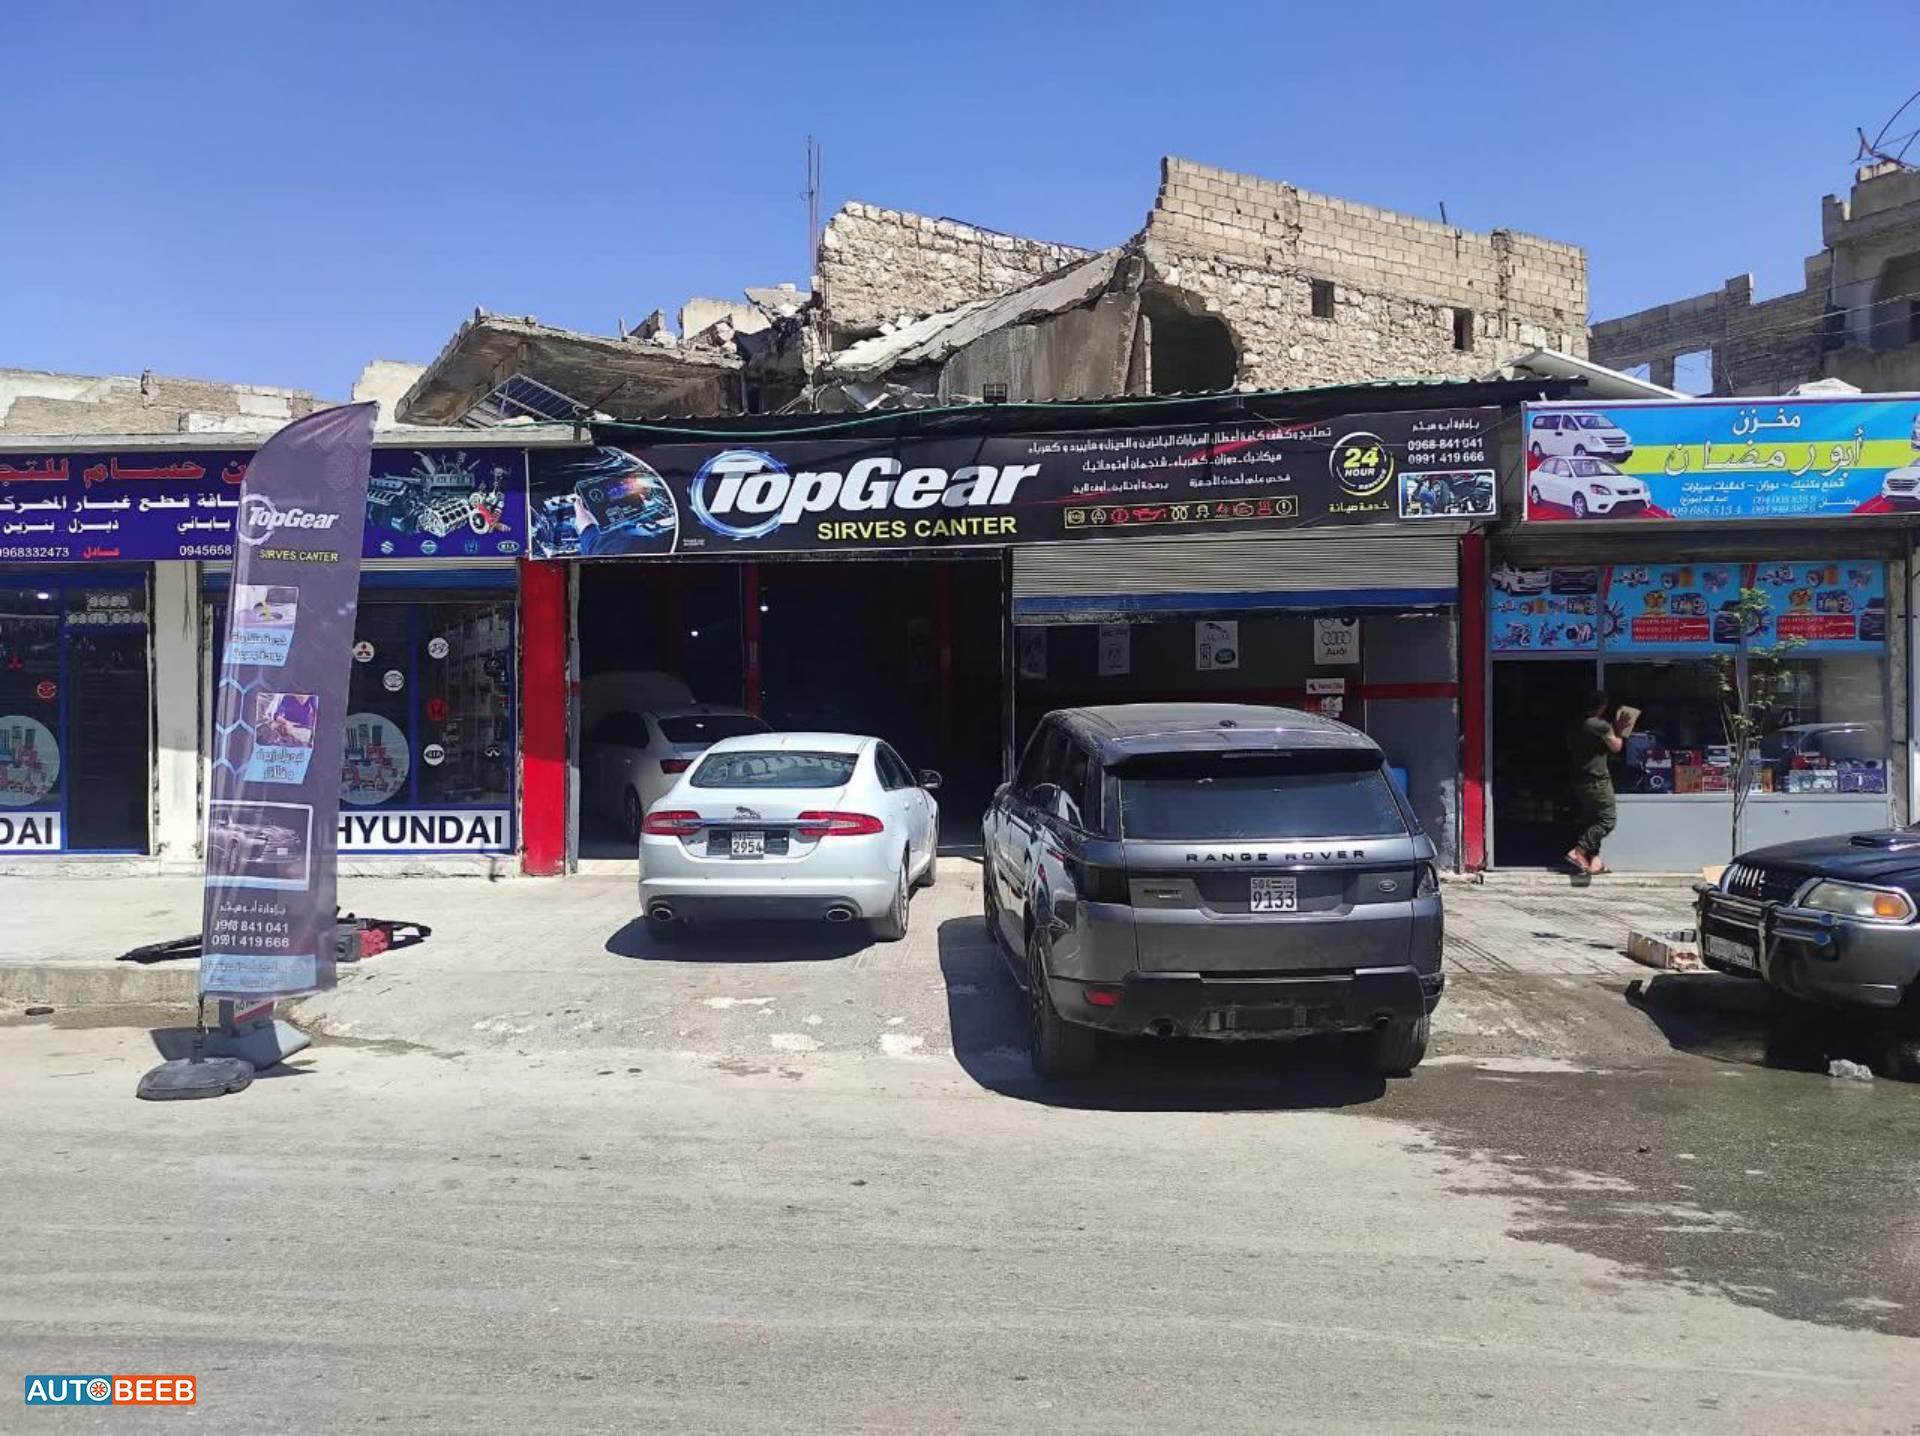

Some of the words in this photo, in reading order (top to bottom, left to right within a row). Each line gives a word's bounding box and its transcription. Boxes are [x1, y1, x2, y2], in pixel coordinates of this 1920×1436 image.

[1732, 407, 1801, 435] مخزن
[1175, 432, 1209, 447] السيارات
[1212, 428, 1240, 445] أعطال
[1298, 426, 1332, 442] تصليح
[1408, 439, 1436, 451] 0968
[1439, 438, 1460, 449] 841
[1820, 426, 1864, 478] أبو
[1344, 447, 1379, 468] 24
[1408, 453, 1436, 465] 0991
[1439, 452, 1461, 463] 419
[1463, 451, 1485, 462] 666
[1665, 440, 1816, 476] رمضان
[0, 457, 69, 487] للتج
[83, 457, 206, 489] حسام
[1345, 468, 1375, 477] HOUR
[709, 457, 1041, 524] TopGear
[0, 495, 66, 513] المحرك
[72, 495, 131, 512] غيار
[139, 494, 190, 512] قطع
[197, 493, 239, 507] افة
[1329, 502, 1358, 514] صيانة
[1359, 500, 1390, 511] خدمة
[69, 518, 119, 533] ديزل
[177, 516, 231, 535] ياباني
[249, 506, 340, 530] TopGear
[3, 519, 55, 534] بنزين
[817, 519, 907, 540] SIRVES
[914, 517, 1018, 537] CANTER
[179, 545, 234, 557] 0945658
[259, 549, 297, 561] SIRVES
[300, 550, 339, 562] CANTER
[337, 815, 502, 844] HYUNDAI
[733, 841, 761, 853] 2954
[1186, 853, 1268, 863] RANGE
[1285, 850, 1365, 861] ROVER
[1253, 890, 1294, 909] 9133
[241, 921, 262, 932] 841
[265, 922, 289, 933] 041
[240, 935, 262, 948] 419
[265, 937, 289, 948] 666
